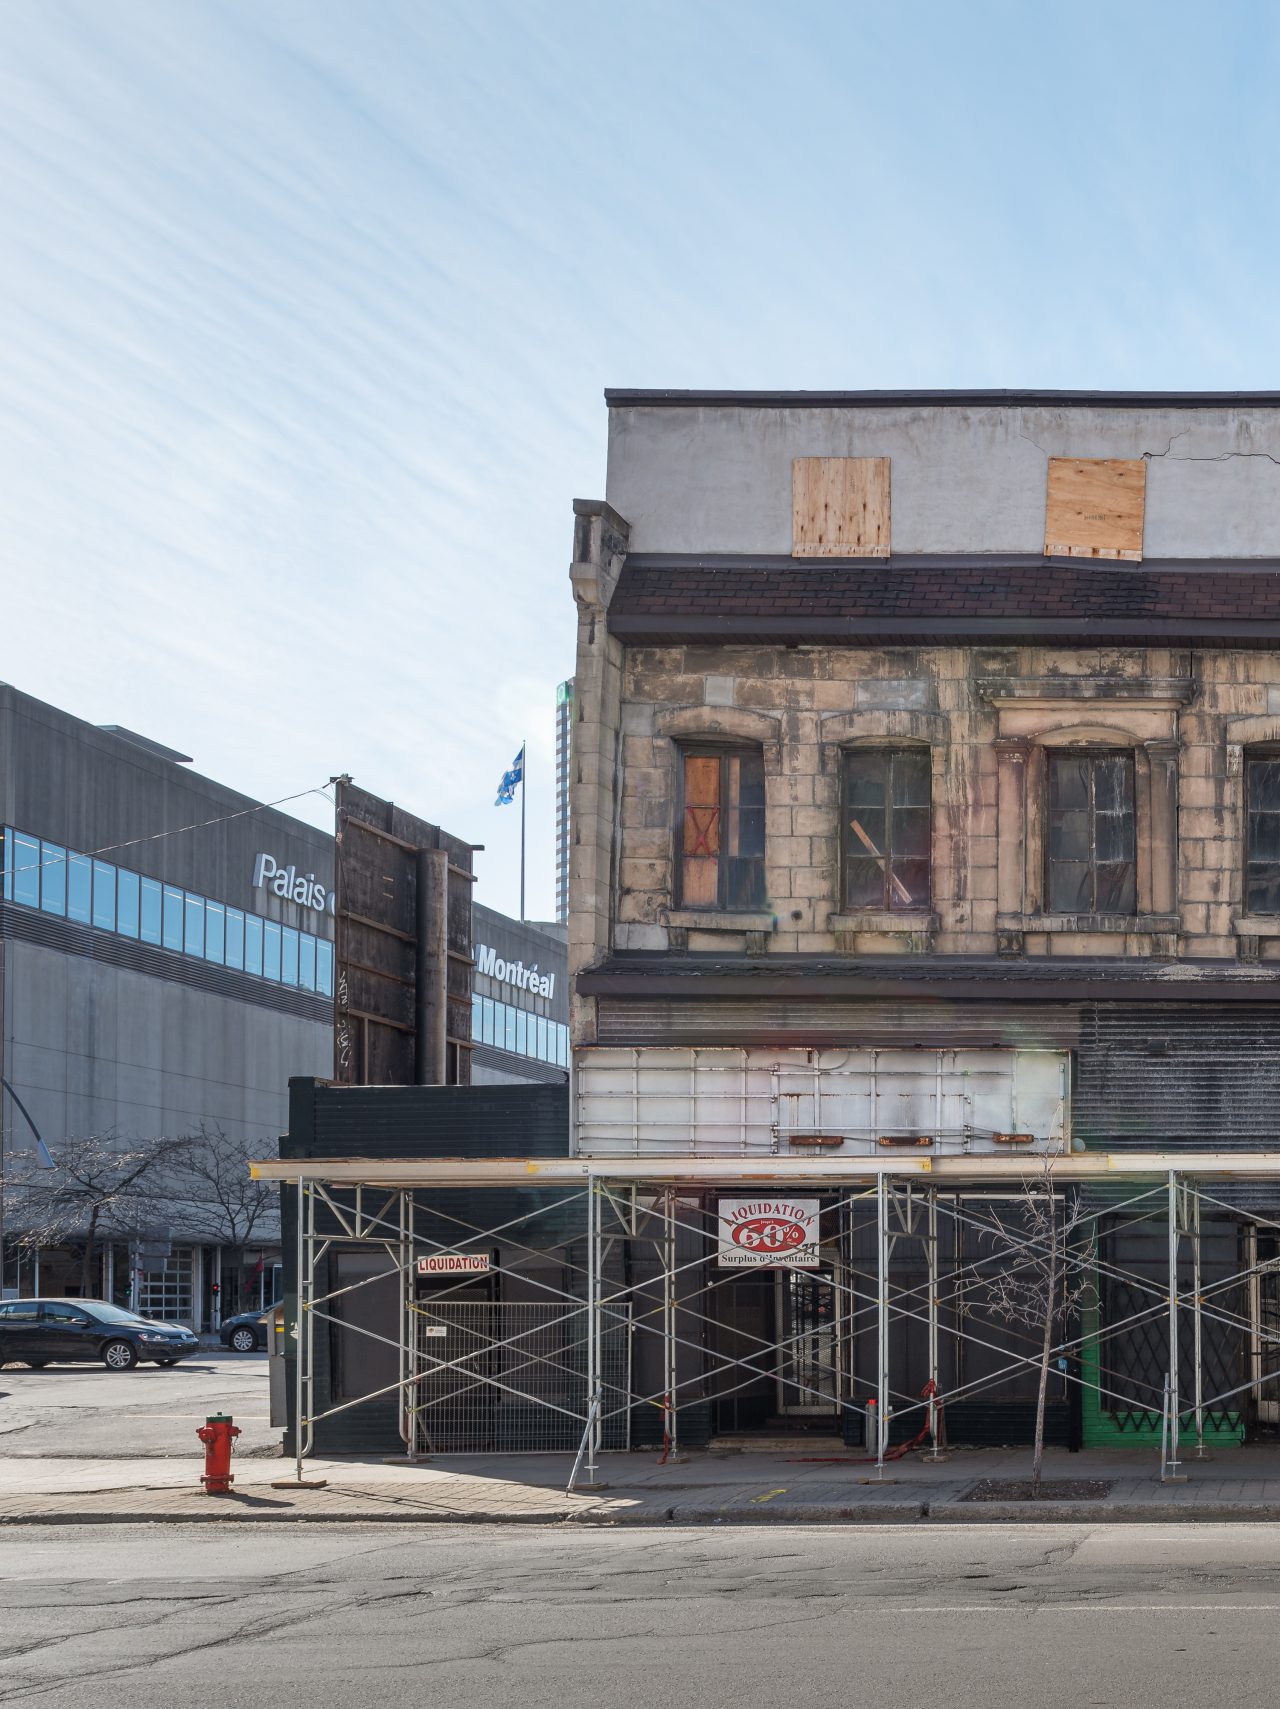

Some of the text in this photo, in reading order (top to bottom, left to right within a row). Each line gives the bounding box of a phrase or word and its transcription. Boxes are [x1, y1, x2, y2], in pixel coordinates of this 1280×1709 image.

[254, 853, 325, 911] Palais
[478, 944, 555, 999] Montréal
[419, 1256, 488, 1271] LIQUIDATION
[722, 1254, 757, 1264] Surplus
